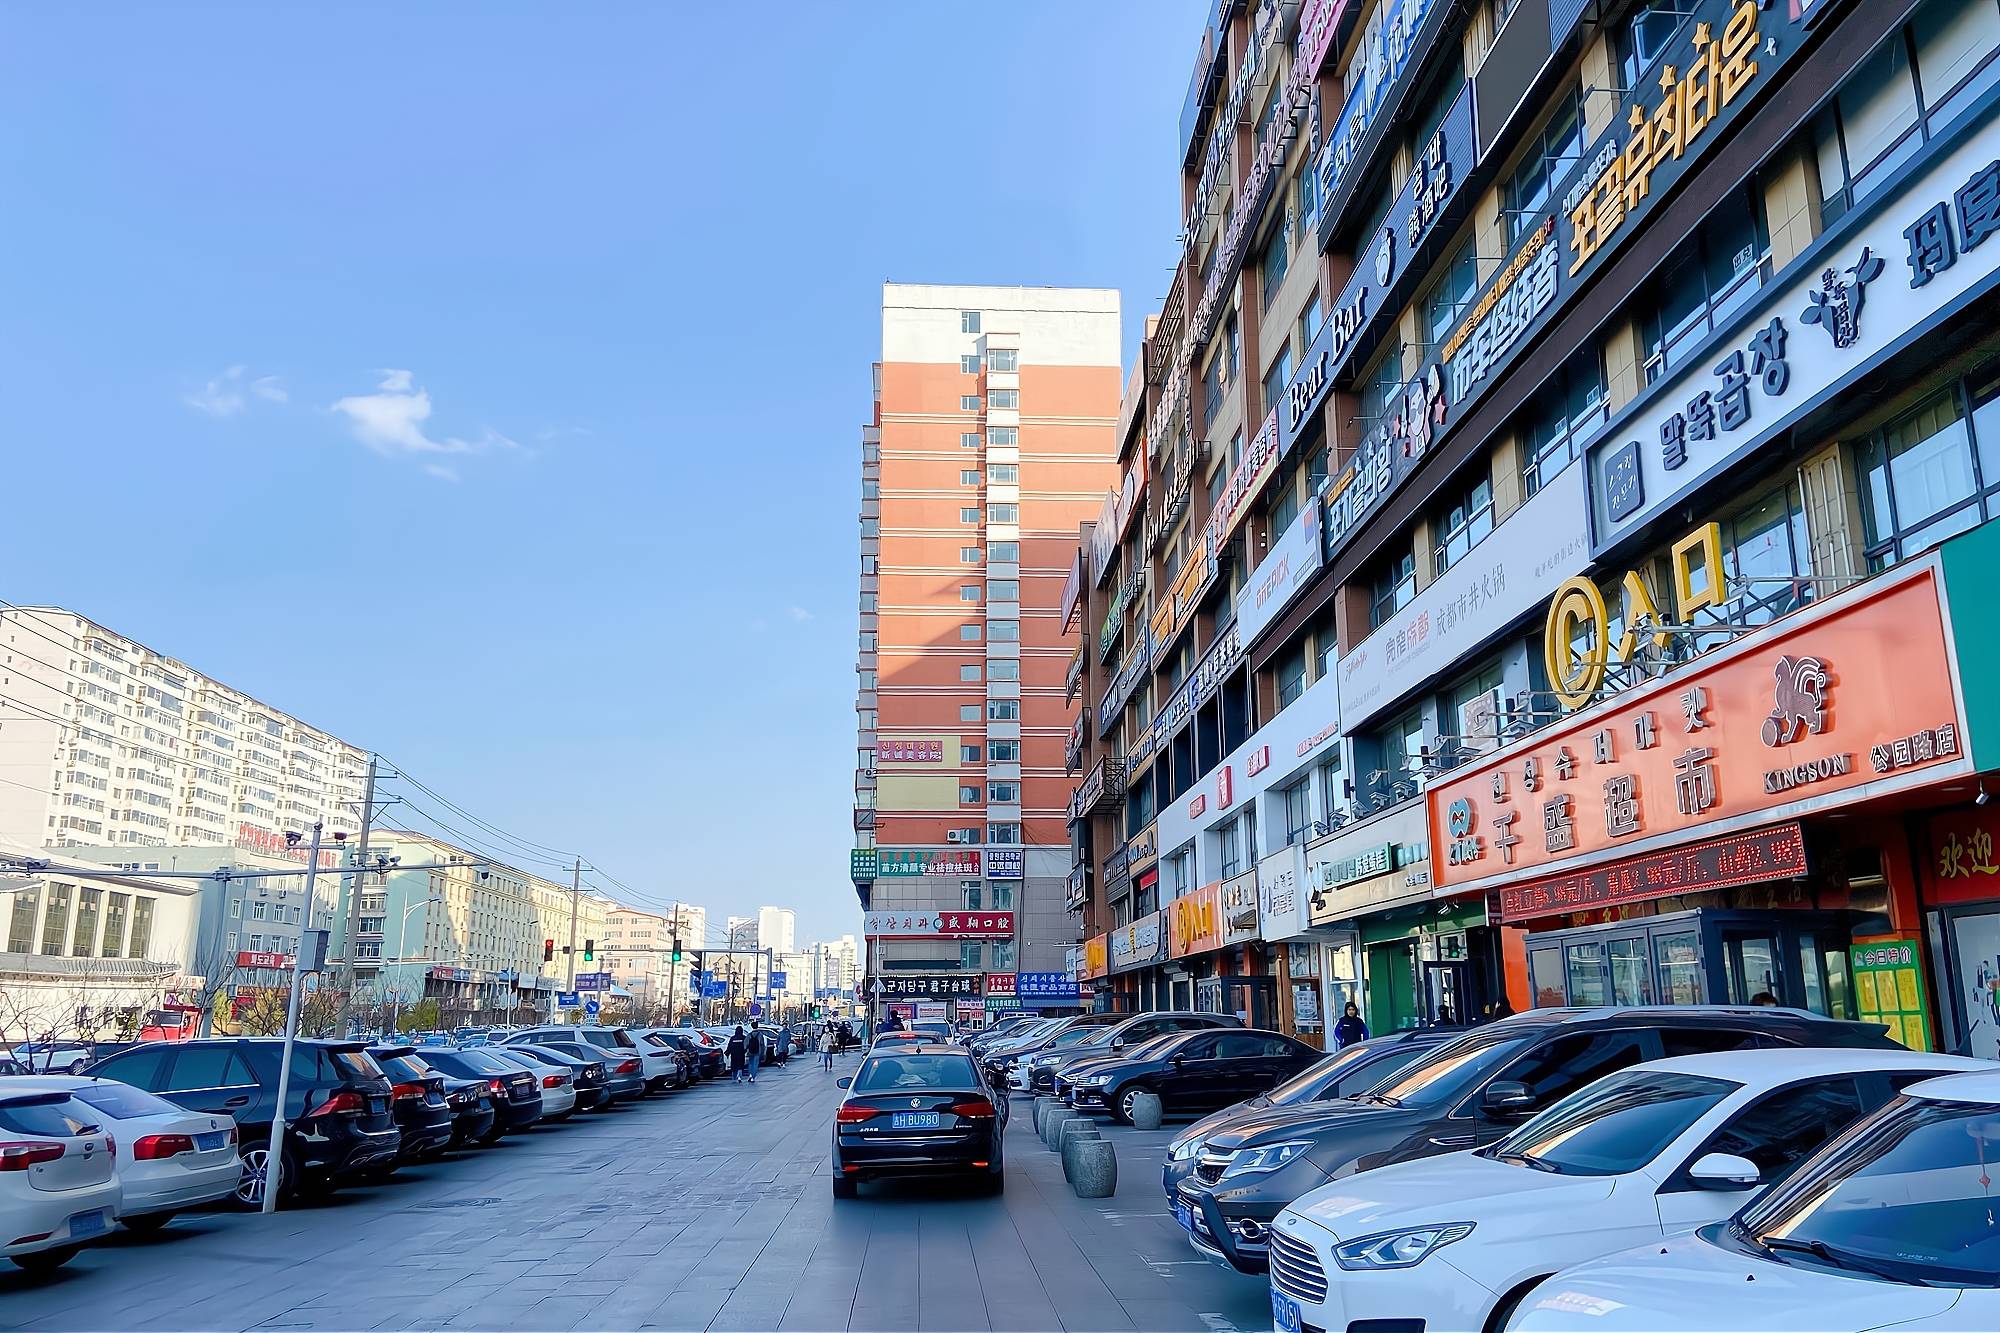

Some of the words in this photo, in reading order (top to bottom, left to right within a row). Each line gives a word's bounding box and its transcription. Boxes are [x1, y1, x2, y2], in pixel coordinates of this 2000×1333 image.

[1408, 163, 1448, 248] 熊酒吧
[1289, 351, 1328, 433] Bear
[1330, 286, 1368, 367] Bar
[1659, 317, 1791, 471] 말뚝곱창
[1436, 562, 1506, 638] 成都市井火锅
[1763, 752, 1852, 793] KINGSON
[1869, 723, 1955, 773] 公园路店
[1493, 746, 1720, 866] 千盛超市
[948, 916, 1010, 929] 盛翔口腔
[1864, 945, 1912, 966] 今日特价
[887, 979, 927, 994] 군자당구
[930, 979, 971, 993] 君子台球
